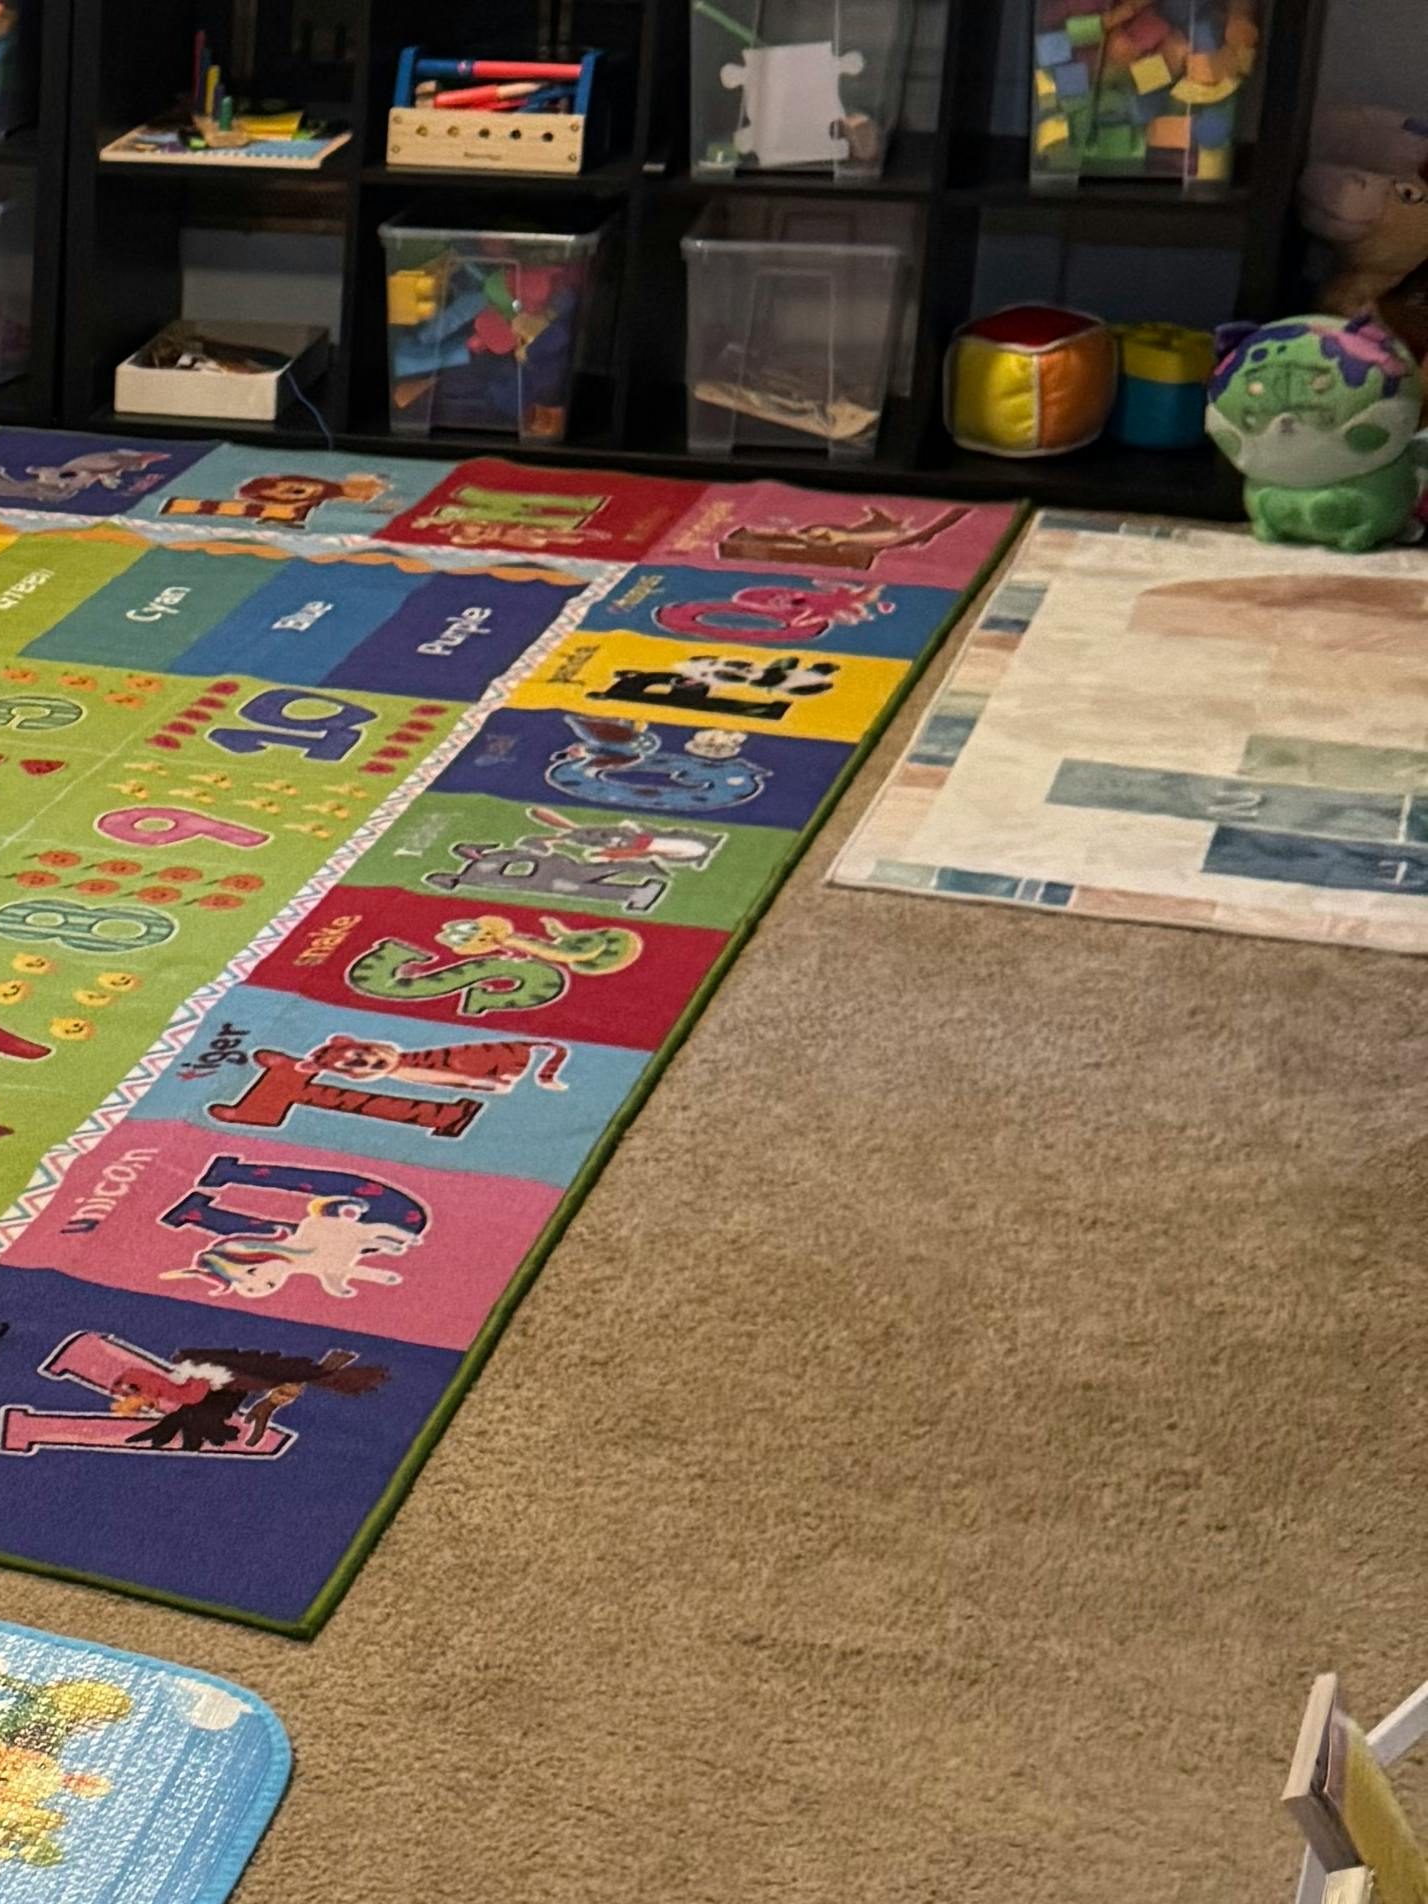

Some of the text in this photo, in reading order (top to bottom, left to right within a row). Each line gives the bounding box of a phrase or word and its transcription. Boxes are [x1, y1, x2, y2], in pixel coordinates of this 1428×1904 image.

[126, 586, 192, 623] Cyan
[270, 601, 335, 631] Blue
[417, 607, 493, 657] Purple
[206, 687, 379, 761] 10
[94, 807, 273, 849] 9
[422, 841, 675, 915] R
[293, 913, 363, 968] snake
[346, 936, 570, 1016] S
[176, 1021, 250, 1082] tiger
[205, 1046, 489, 1139] T
